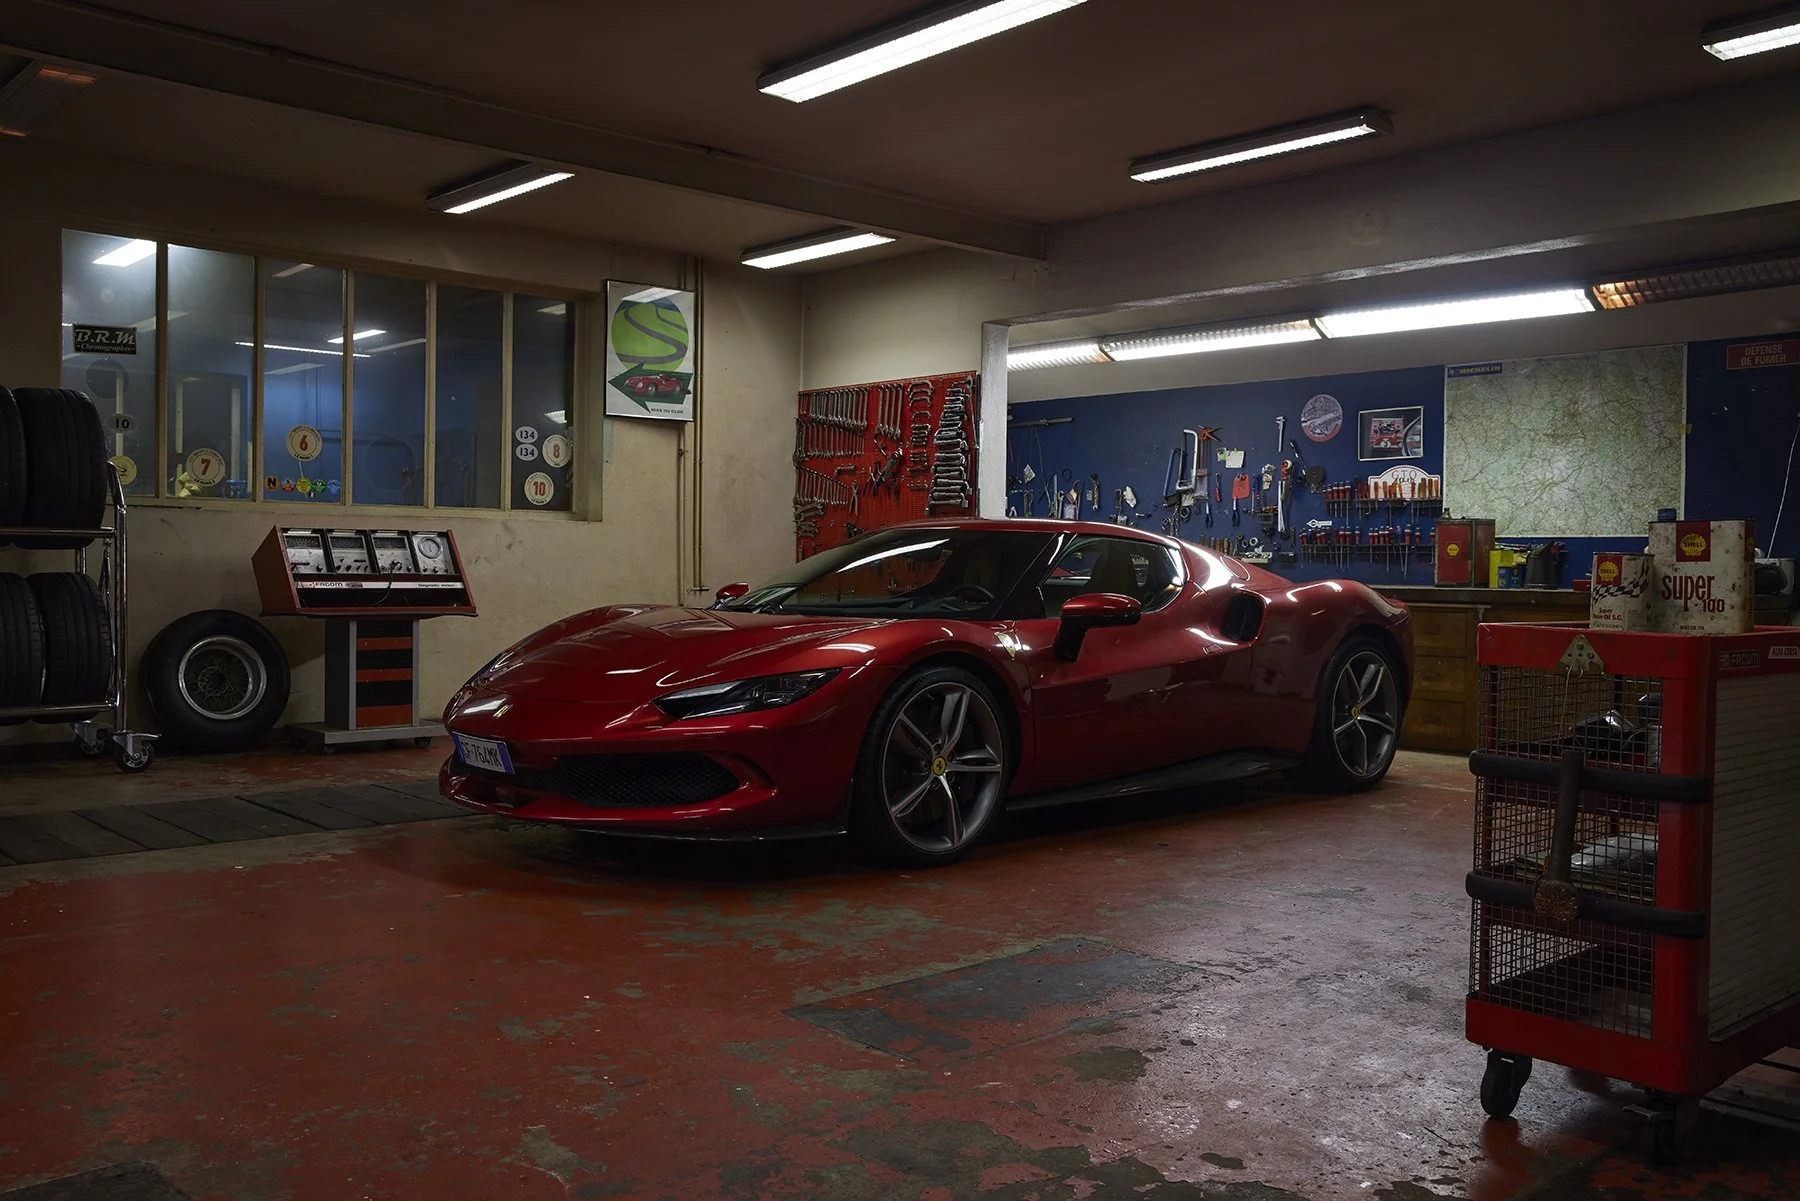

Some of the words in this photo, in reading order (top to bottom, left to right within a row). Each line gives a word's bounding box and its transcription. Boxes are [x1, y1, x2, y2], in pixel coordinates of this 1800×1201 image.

[1741, 356, 1752, 366] DE
[1755, 354, 1786, 365] FUMER
[1460, 365, 1500, 374] MICHELIN
[116, 419, 129, 429] 10
[520, 430, 535, 439] 134
[300, 435, 308, 451] 6
[520, 448, 535, 457] 134
[553, 444, 560, 459] 8
[201, 459, 211, 475] 7
[1391, 470, 1417, 480] GTO
[533, 481, 546, 496] 10
[1662, 575, 1715, 611] super
[1773, 647, 1784, 656] ALFA
